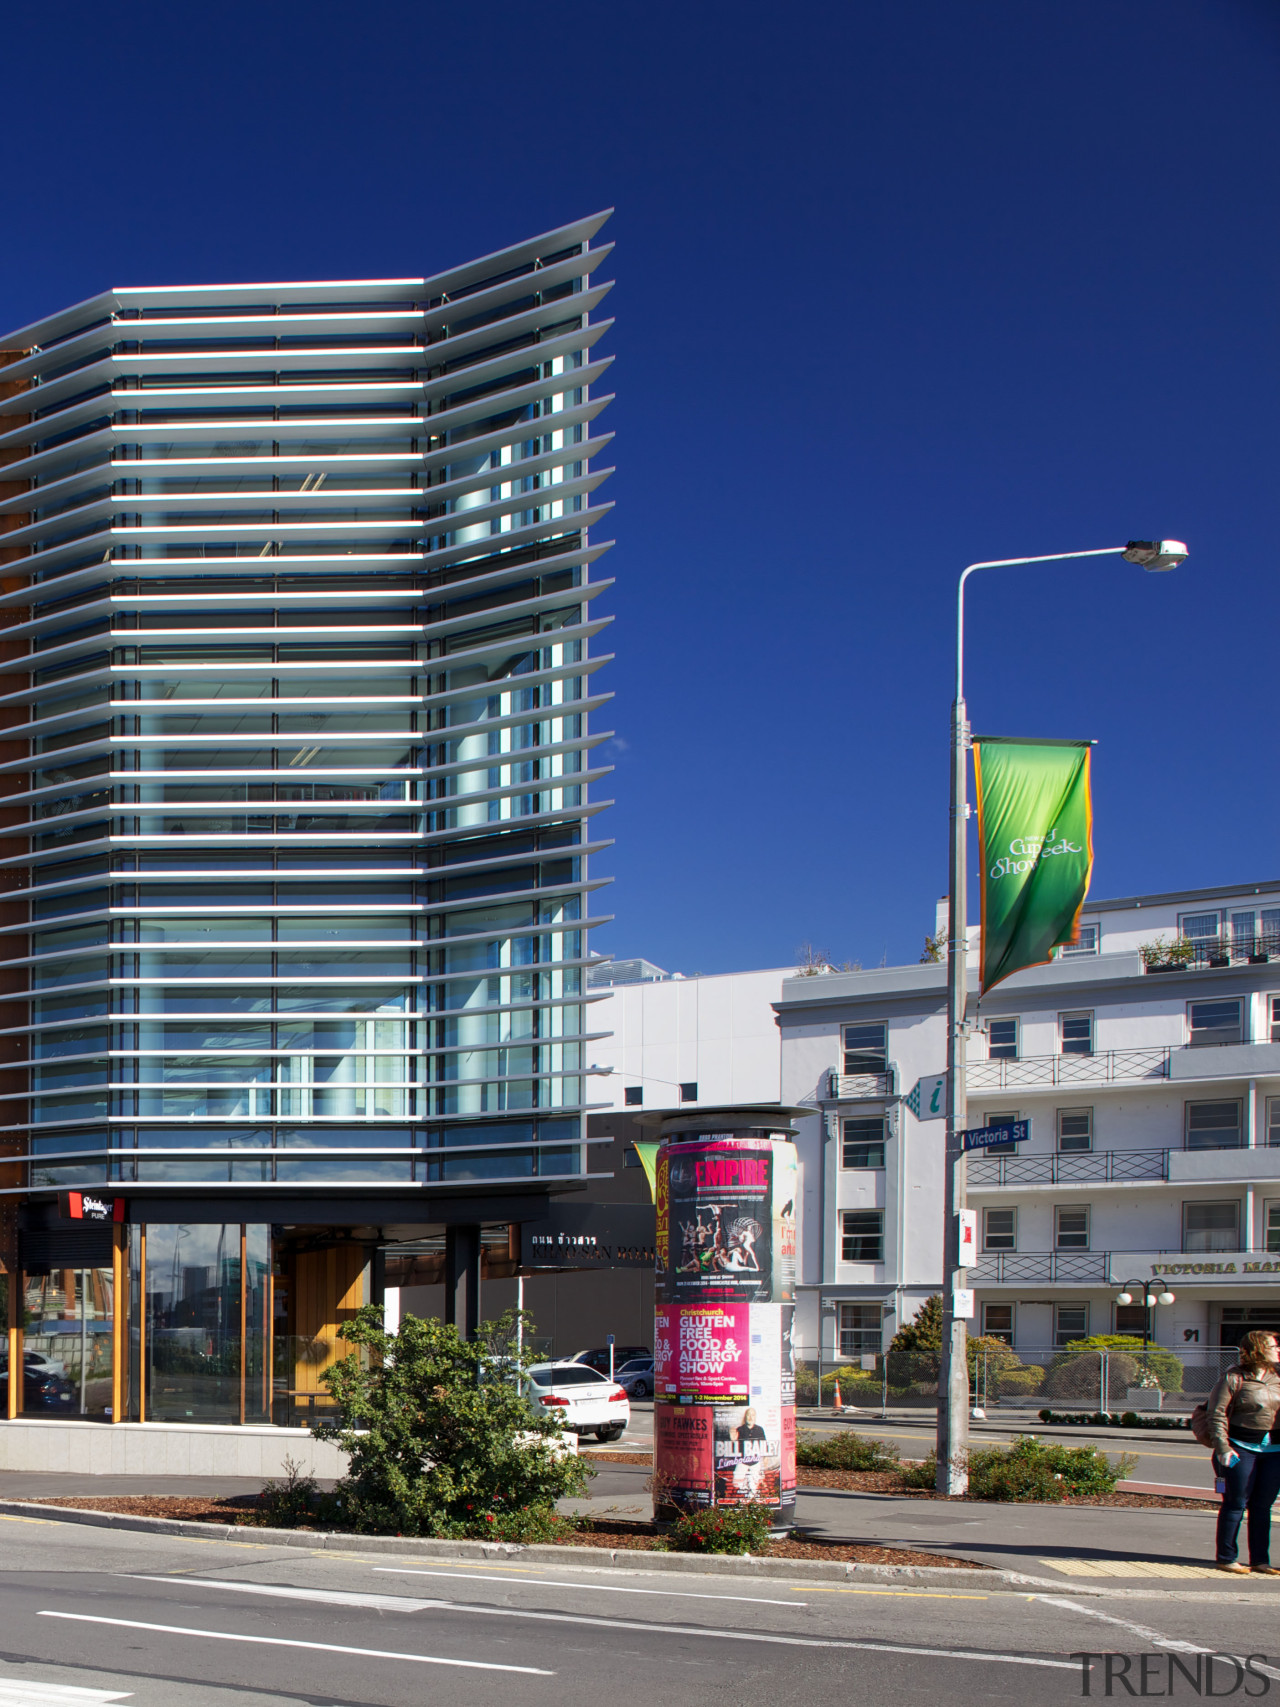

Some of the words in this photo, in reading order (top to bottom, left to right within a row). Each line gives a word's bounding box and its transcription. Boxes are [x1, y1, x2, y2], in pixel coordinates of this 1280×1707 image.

[1009, 838, 1042, 859] Cup
[1041, 838, 1083, 858] eek
[968, 1128, 1008, 1146] Victoria
[1012, 1124, 1025, 1138] St
[695, 1159, 769, 1187] EMPIRE
[91, 1212, 105, 1220] PURE
[1150, 1262, 1238, 1276] VICTORIA
[680, 1308, 724, 1316] Christchurch
[679, 1315, 735, 1328] GLUTEN
[679, 1327, 712, 1339] FREE
[1183, 1328, 1200, 1342] 91
[679, 1338, 721, 1351] FOOD
[724, 1338, 738, 1351] &
[679, 1350, 742, 1362] ALLERGY
[679, 1361, 725, 1374] SHOW
[673, 1417, 708, 1431] FAWKES
[715, 1440, 743, 1458] BILL
[744, 1440, 780, 1458] BAILEY
[716, 1455, 761, 1470] Limboland
